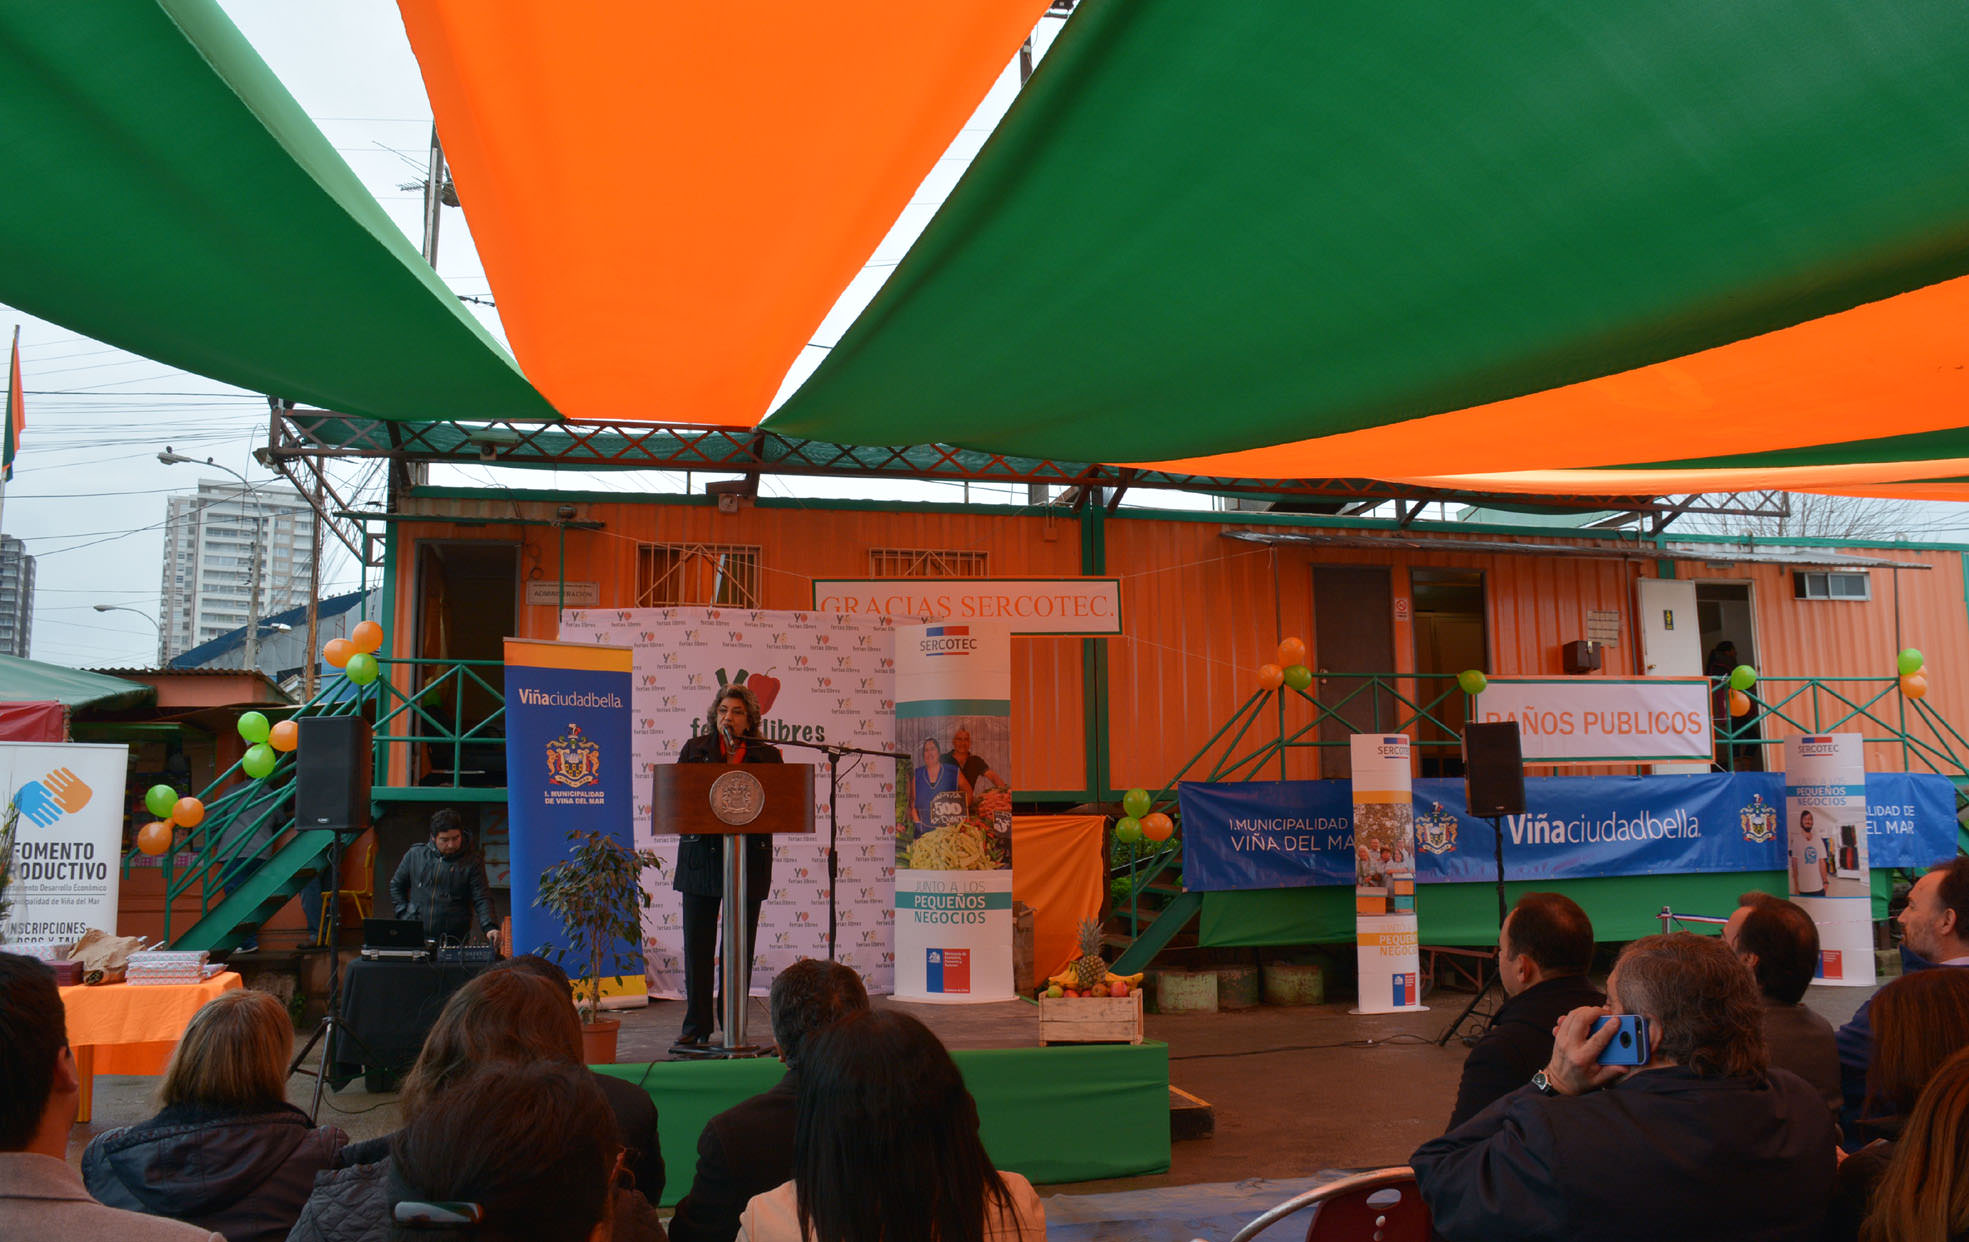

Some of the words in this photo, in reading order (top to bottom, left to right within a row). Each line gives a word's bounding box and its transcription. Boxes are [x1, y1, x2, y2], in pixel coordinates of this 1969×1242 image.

[821, 595, 952, 617] GRACIAS
[961, 595, 1115, 617] SERCOTEC.
[920, 639, 978, 651] SERCOTEC
[1584, 711, 1702, 735] PUBLICOS
[763, 719, 825, 742] libres
[1797, 744, 1839, 754] SERCOTEC
[1796, 785, 1847, 797] PEQUEÑOS
[1797, 798, 1847, 806] NEGOCIOS
[1904, 805, 1915, 816] DE
[1886, 820, 1915, 834] MAR
[1231, 833, 1280, 851] VIÑA
[1284, 835, 1320, 851] DEL
[1327, 835, 1355, 850] MA
[14, 842, 95, 860] FOMENTO
[20, 862, 107, 880] ODUCTIVO
[915, 880, 946, 892] JUNTO
[950, 880, 959, 892] A
[963, 880, 986, 892] LOS
[88, 897, 100, 905] Mar
[914, 893, 986, 910] PEQUEÑOS
[914, 911, 986, 924] NEGOCIOS
